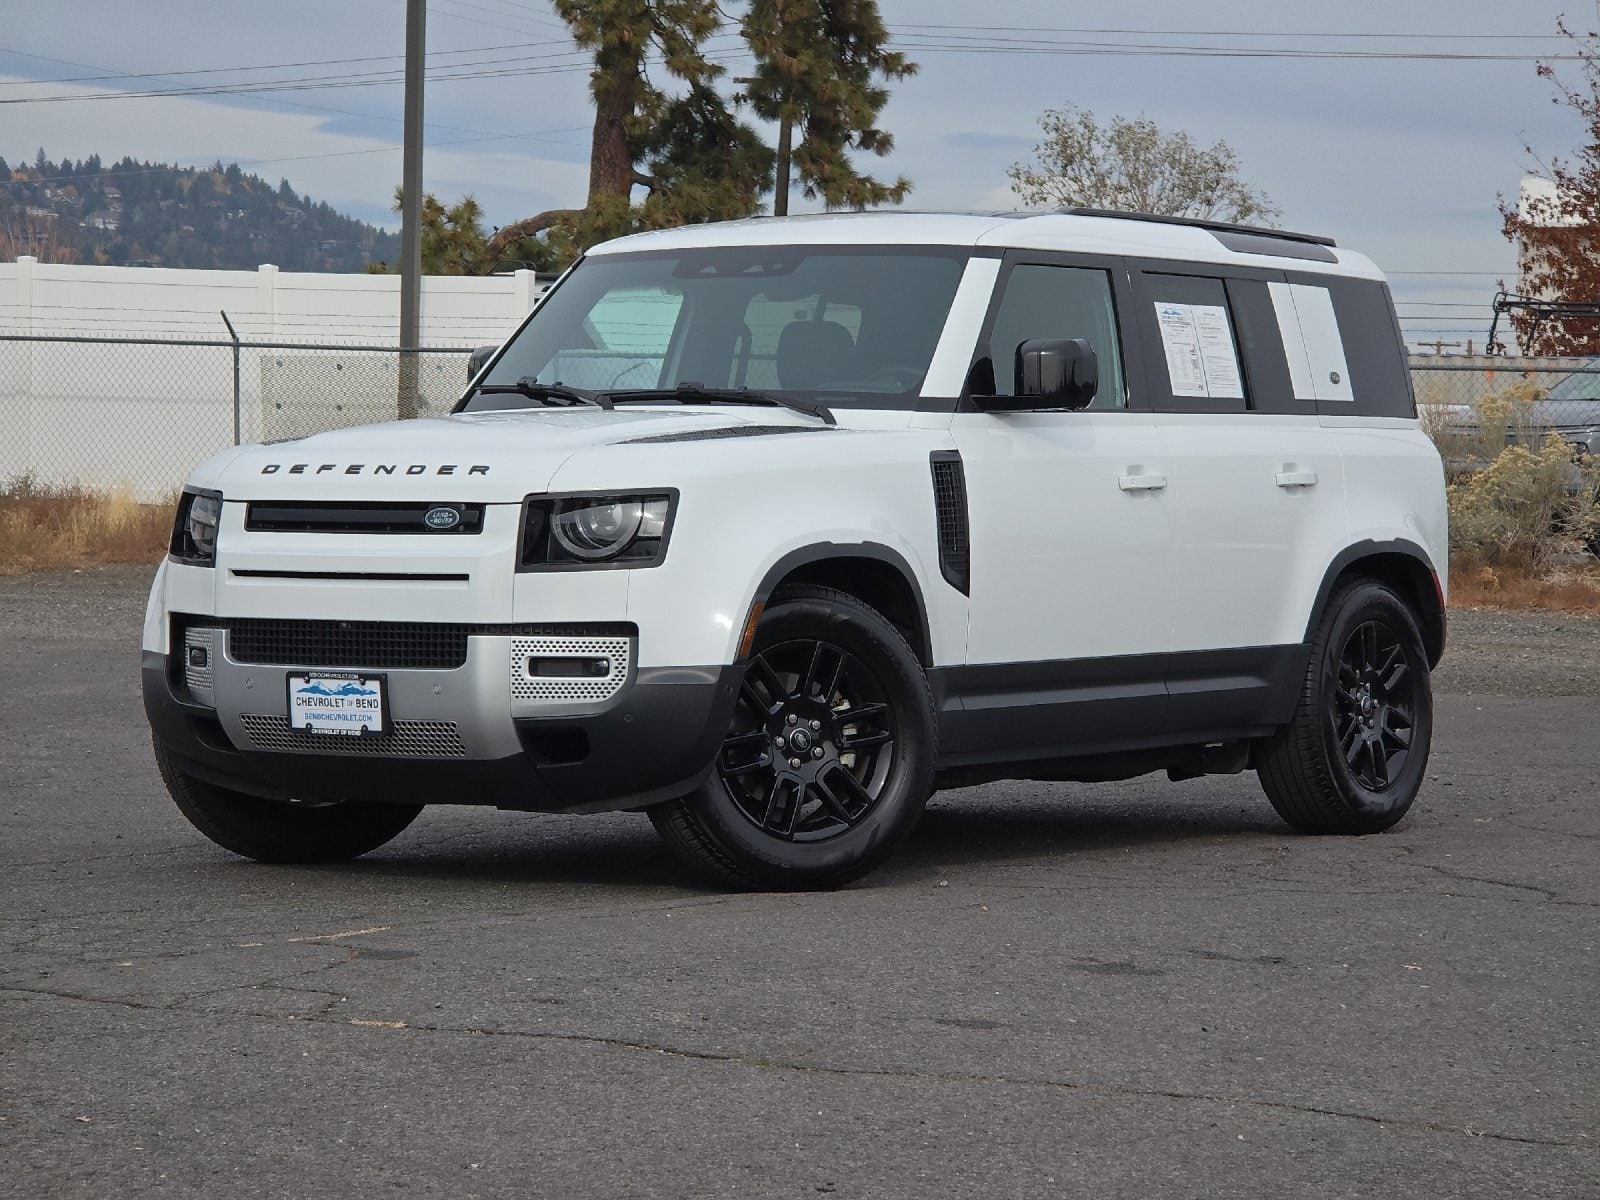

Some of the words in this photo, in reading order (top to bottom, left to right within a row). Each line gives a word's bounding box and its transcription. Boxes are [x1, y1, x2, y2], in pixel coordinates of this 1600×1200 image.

[261, 464, 491, 476] DEFENDER
[296, 697, 345, 708] CHEVROLET
[355, 698, 379, 709] BEND
[304, 712, 373, 723] BENDCHEVROLET.COM
